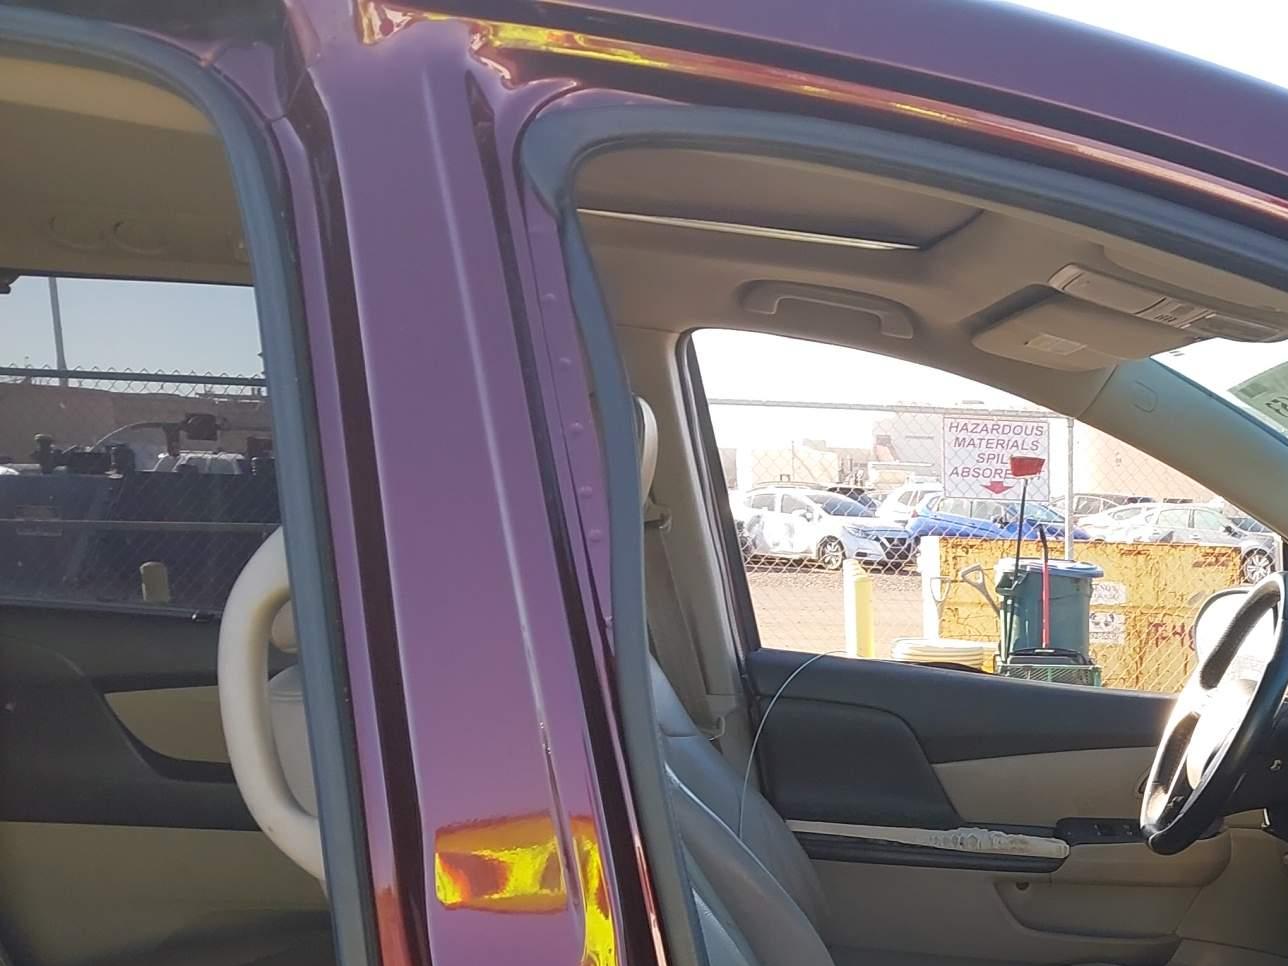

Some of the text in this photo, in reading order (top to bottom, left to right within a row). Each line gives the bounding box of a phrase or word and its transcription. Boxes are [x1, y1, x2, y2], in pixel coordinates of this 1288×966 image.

[948, 422, 1044, 437] HAZARDOUS
[953, 437, 1039, 452] MATERIALS
[976, 453, 1013, 465] SPIL
[949, 467, 1045, 480] ABSORB
